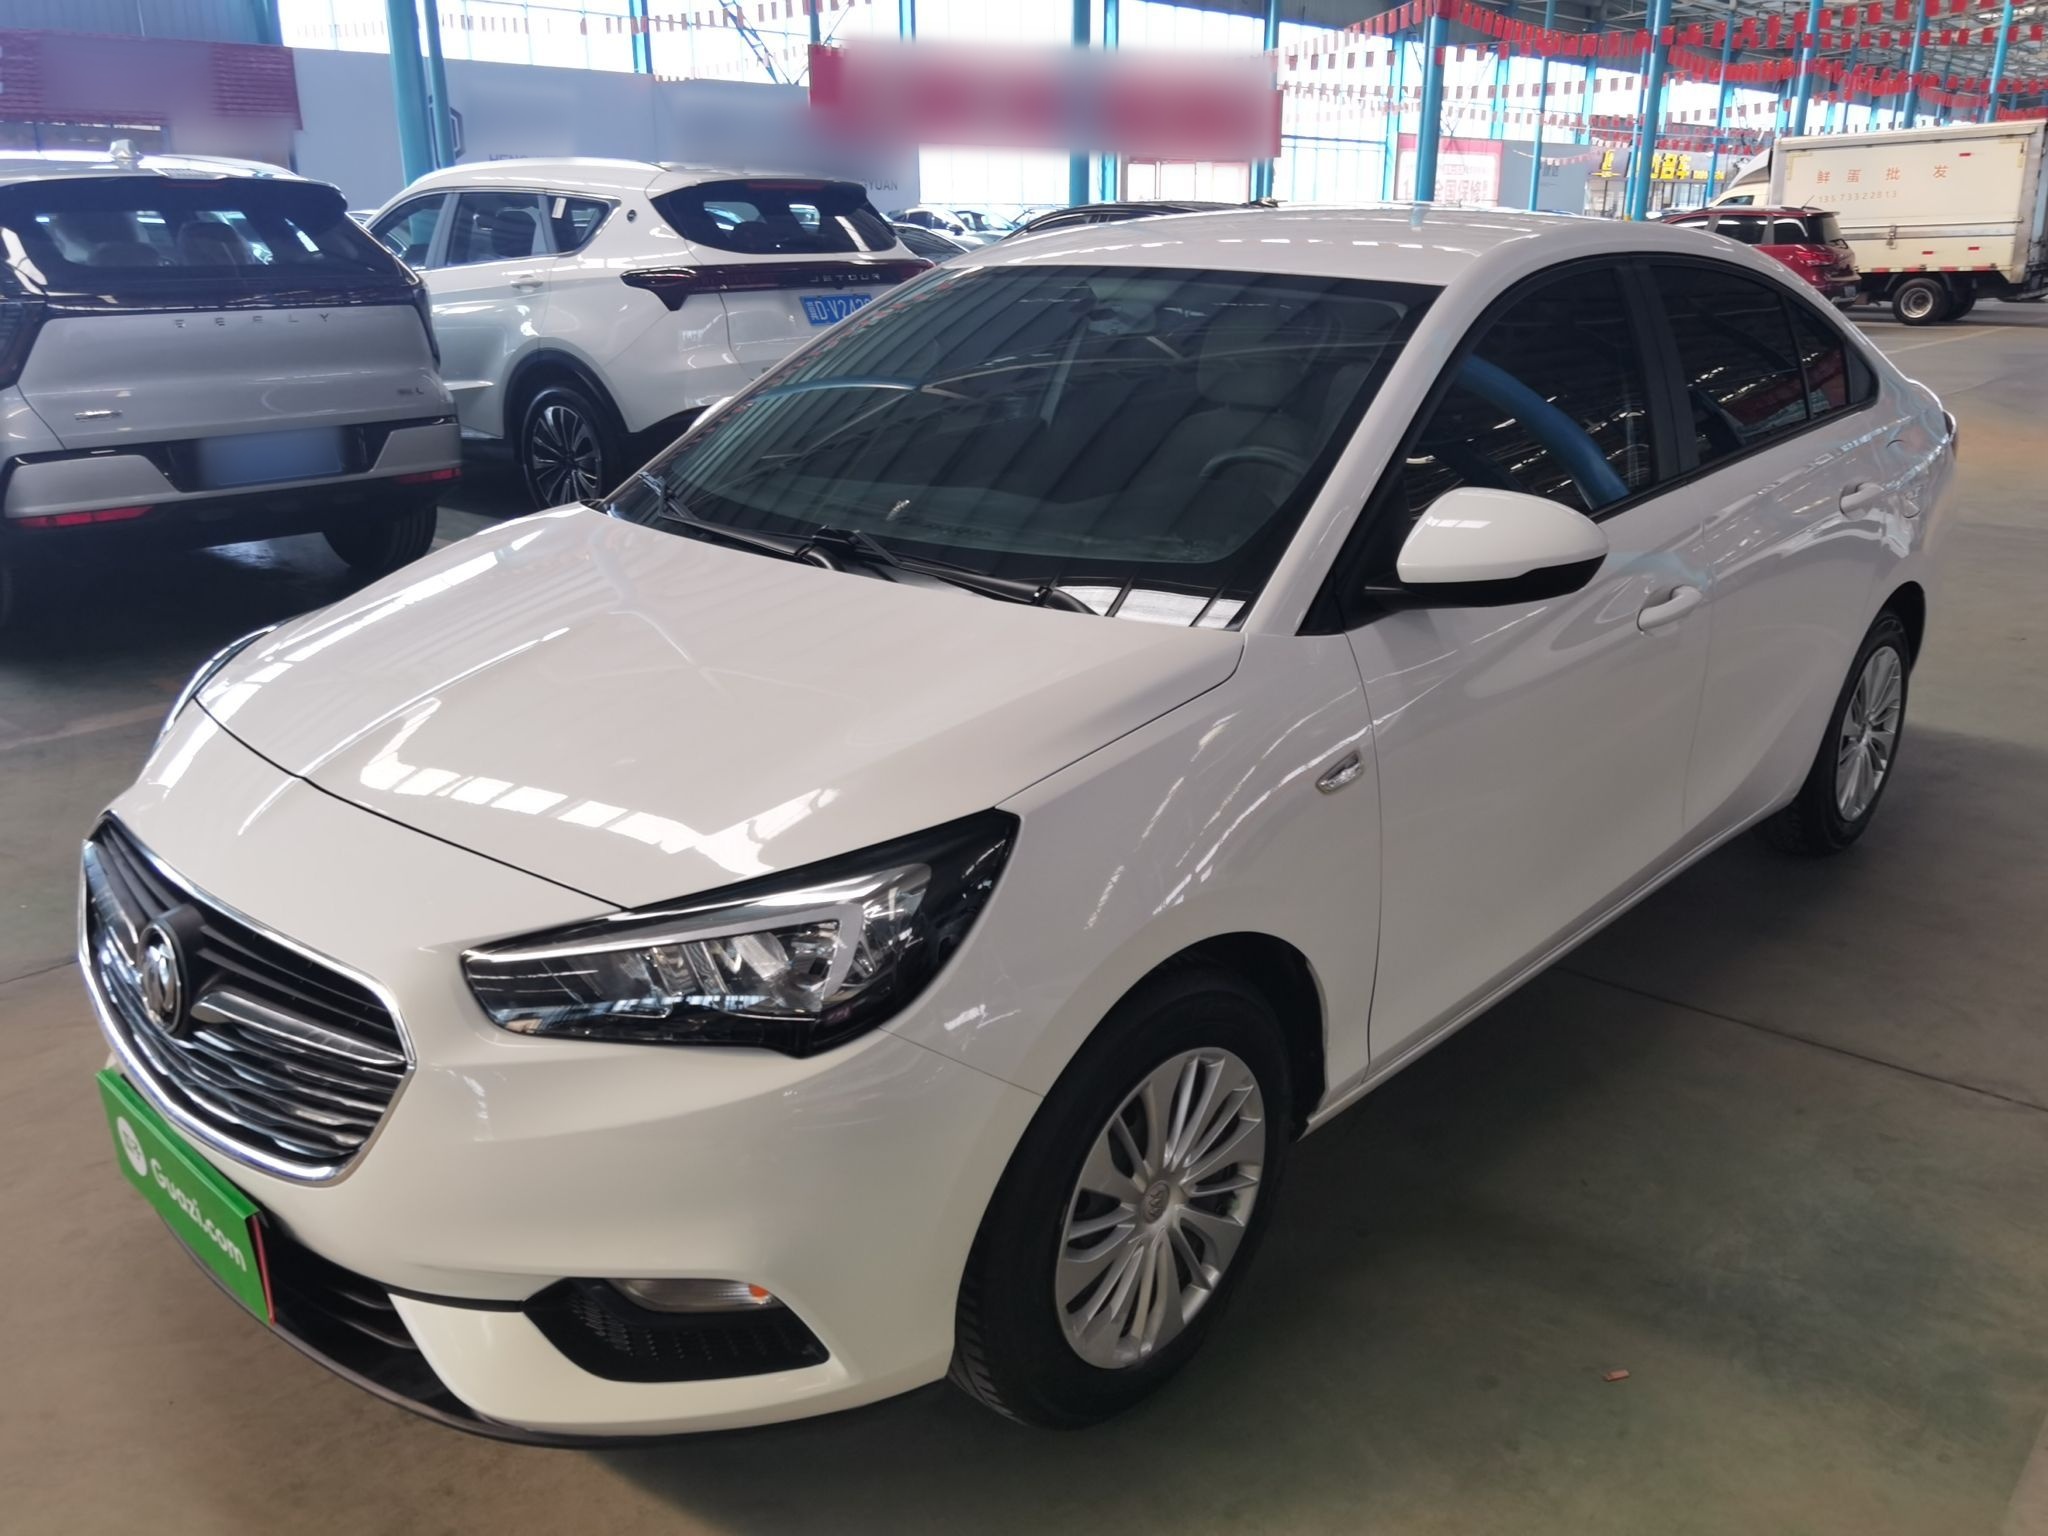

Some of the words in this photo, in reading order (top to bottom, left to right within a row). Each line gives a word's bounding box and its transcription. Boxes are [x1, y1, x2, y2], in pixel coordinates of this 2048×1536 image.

[1816, 163, 1949, 184] 鲜蛋批发
[810, 273, 881, 283] JETOUR
[151, 1157, 248, 1273] Guazi.com
